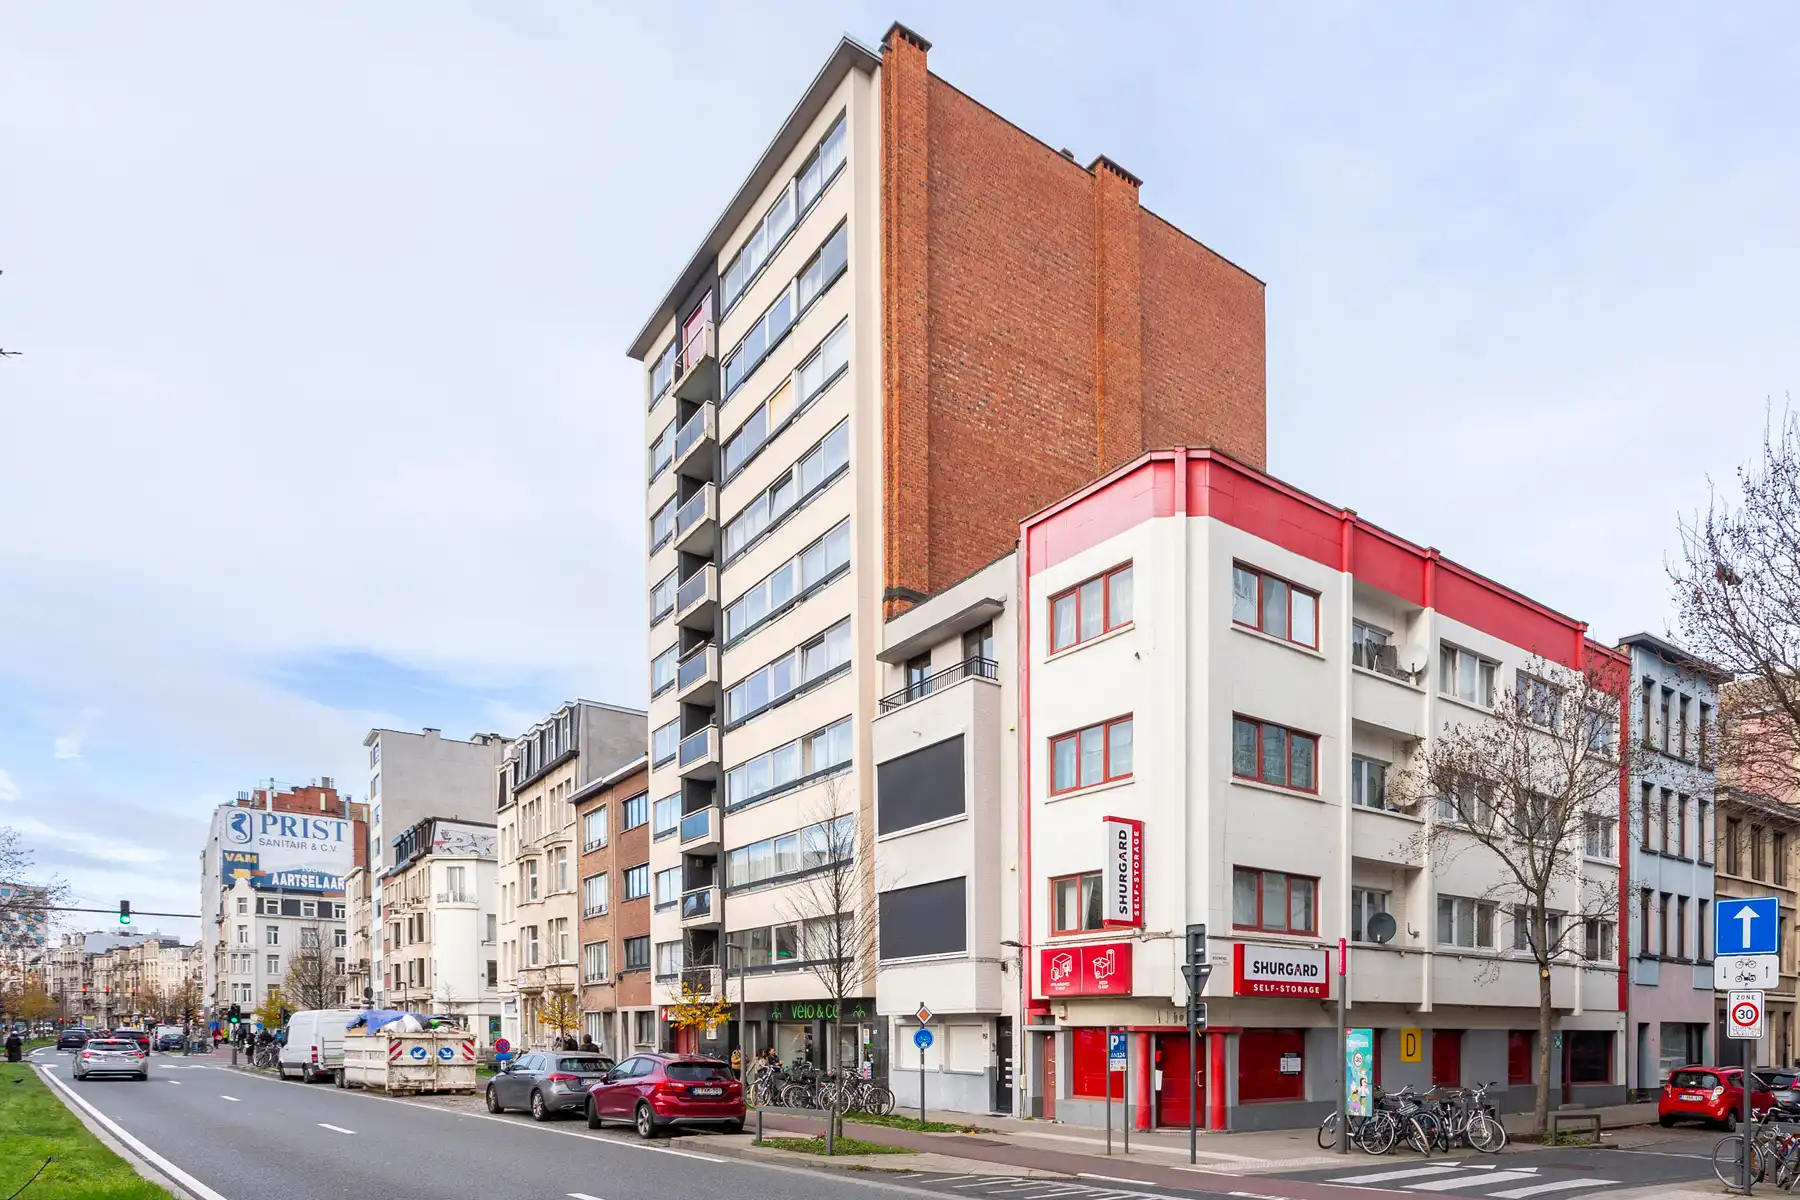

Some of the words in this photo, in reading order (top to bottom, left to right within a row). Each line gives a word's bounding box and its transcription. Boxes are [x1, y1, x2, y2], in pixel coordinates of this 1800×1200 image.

[259, 813, 348, 842] PRIST
[259, 837, 307, 850] SANITAIR
[311, 843, 317, 851] &
[224, 852, 257, 864] VAM
[1119, 829, 1128, 915] SHURGARD
[272, 872, 345, 890] AARTSELAAR
[1253, 960, 1318, 977] SHURGARD
[1253, 983, 1320, 994] SELF-STORAGE
[817, 1004, 824, 1019] &
[1738, 1009, 1753, 1019] 30
[1110, 1035, 1119, 1050] P
[1406, 1033, 1416, 1057] D
